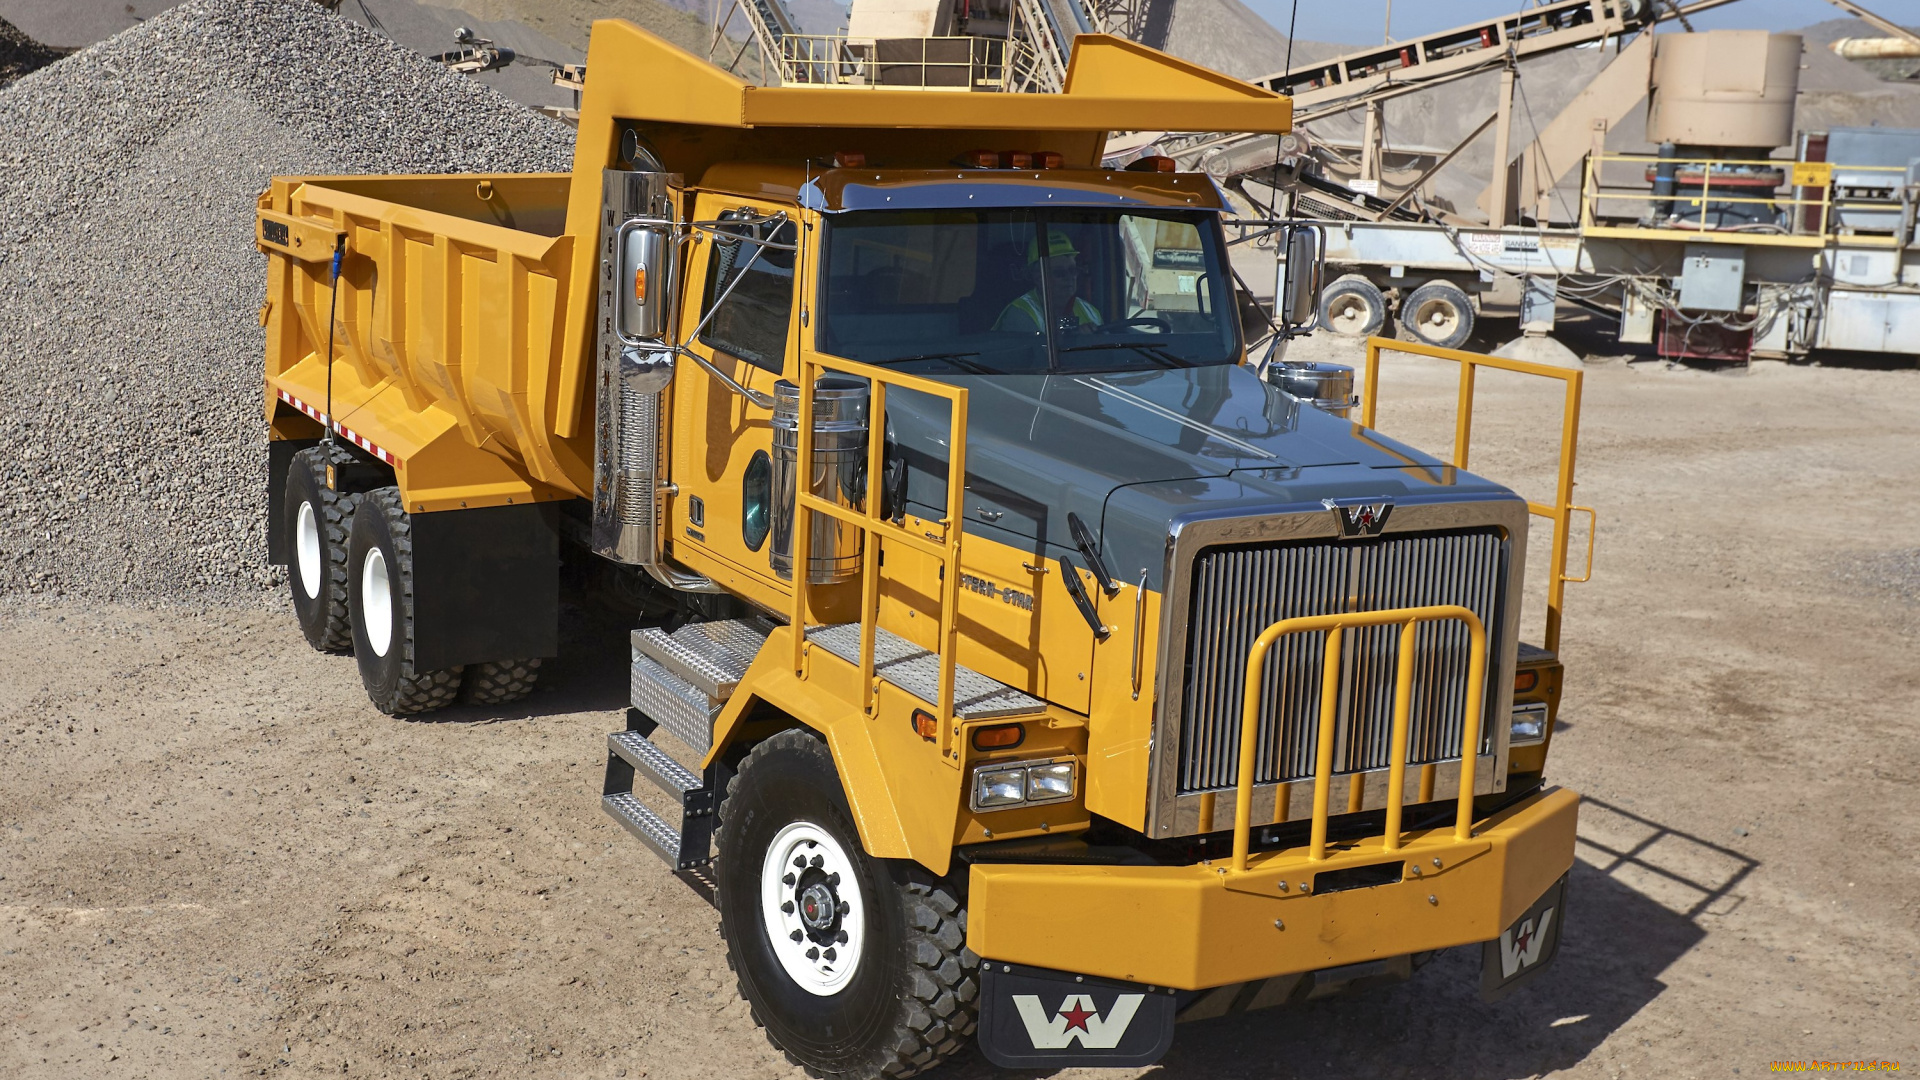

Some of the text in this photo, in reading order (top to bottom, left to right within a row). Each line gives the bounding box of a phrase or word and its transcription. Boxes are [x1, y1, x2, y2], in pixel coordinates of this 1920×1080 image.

[1473, 234, 1500, 242] WARNING
[1505, 240, 1539, 248] SANDVIK
[603, 209, 616, 387] WESTERN
